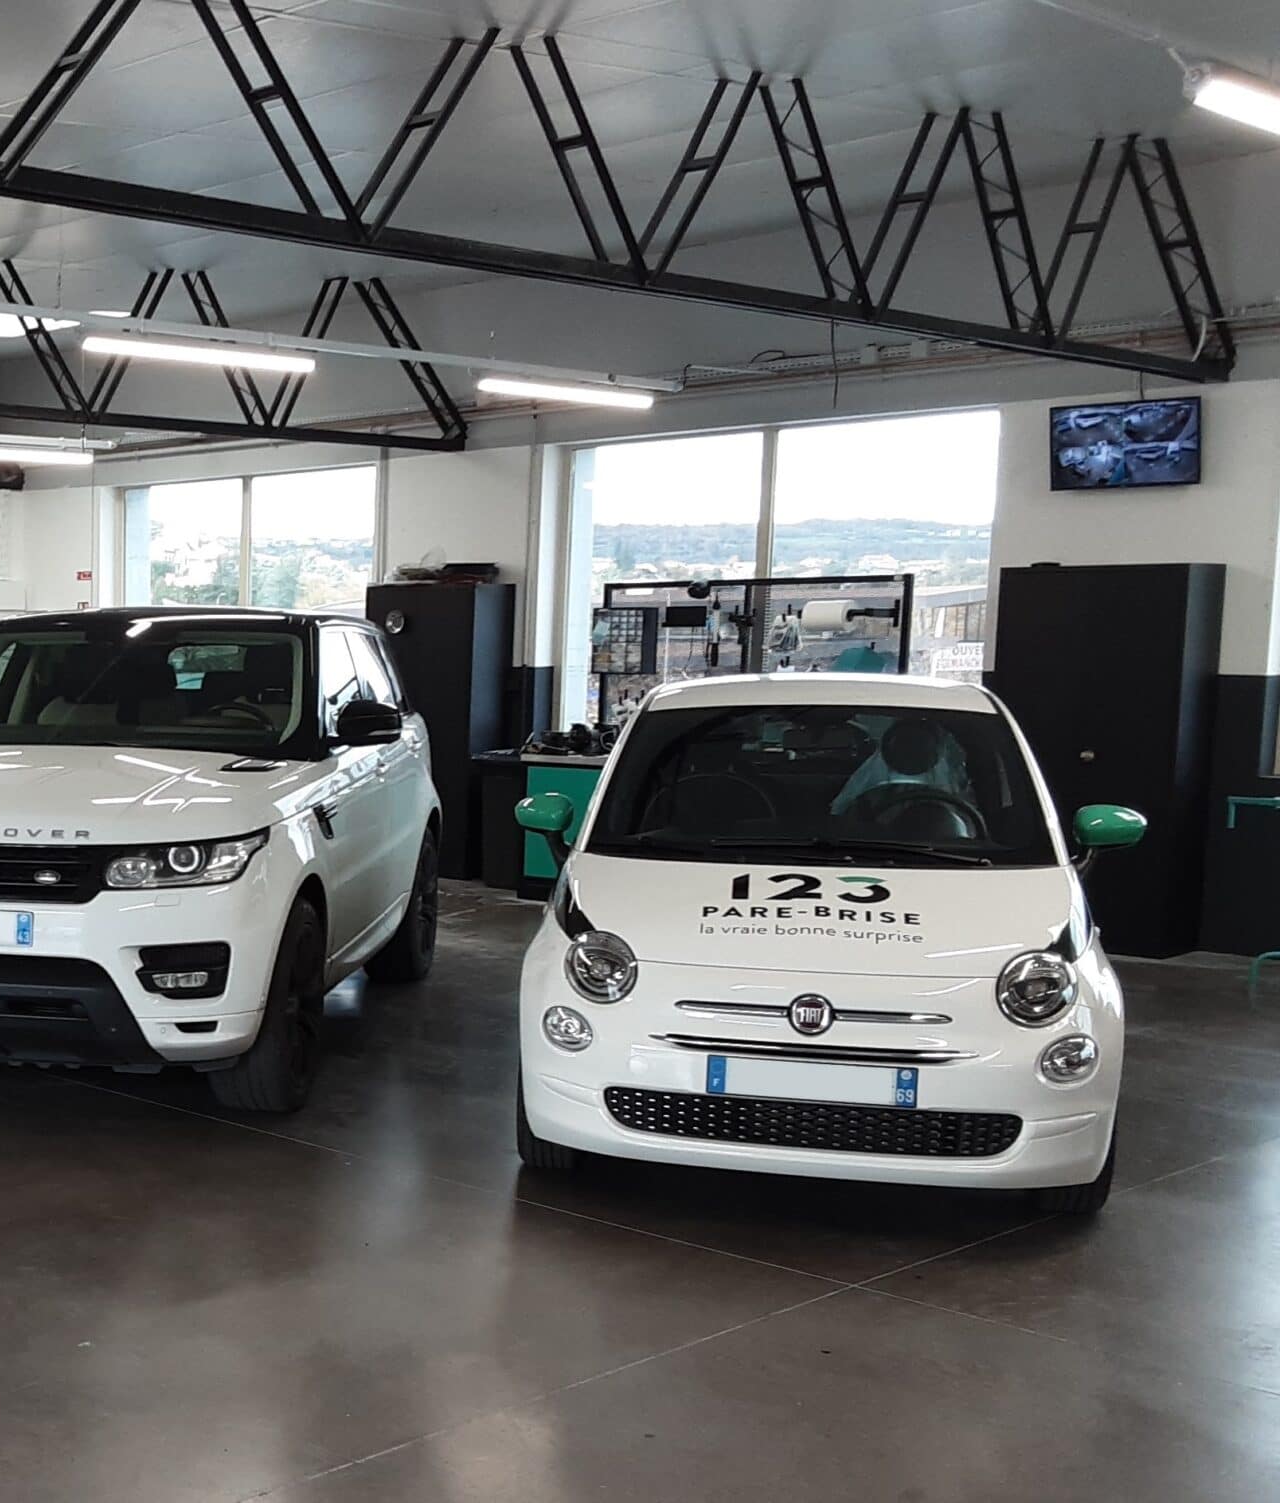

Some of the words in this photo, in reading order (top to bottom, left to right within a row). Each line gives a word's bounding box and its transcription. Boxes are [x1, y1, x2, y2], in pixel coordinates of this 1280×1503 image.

[731, 872, 891, 904] 123
[702, 906, 921, 926] PARE-BRISE
[699, 923, 715, 935] la
[721, 923, 768, 936] vraie
[775, 924, 837, 937] bonne
[844, 929, 924, 944] surprise
[797, 1007, 823, 1023] FIAT
[713, 1078, 720, 1087] F
[897, 1088, 914, 1103] 69
